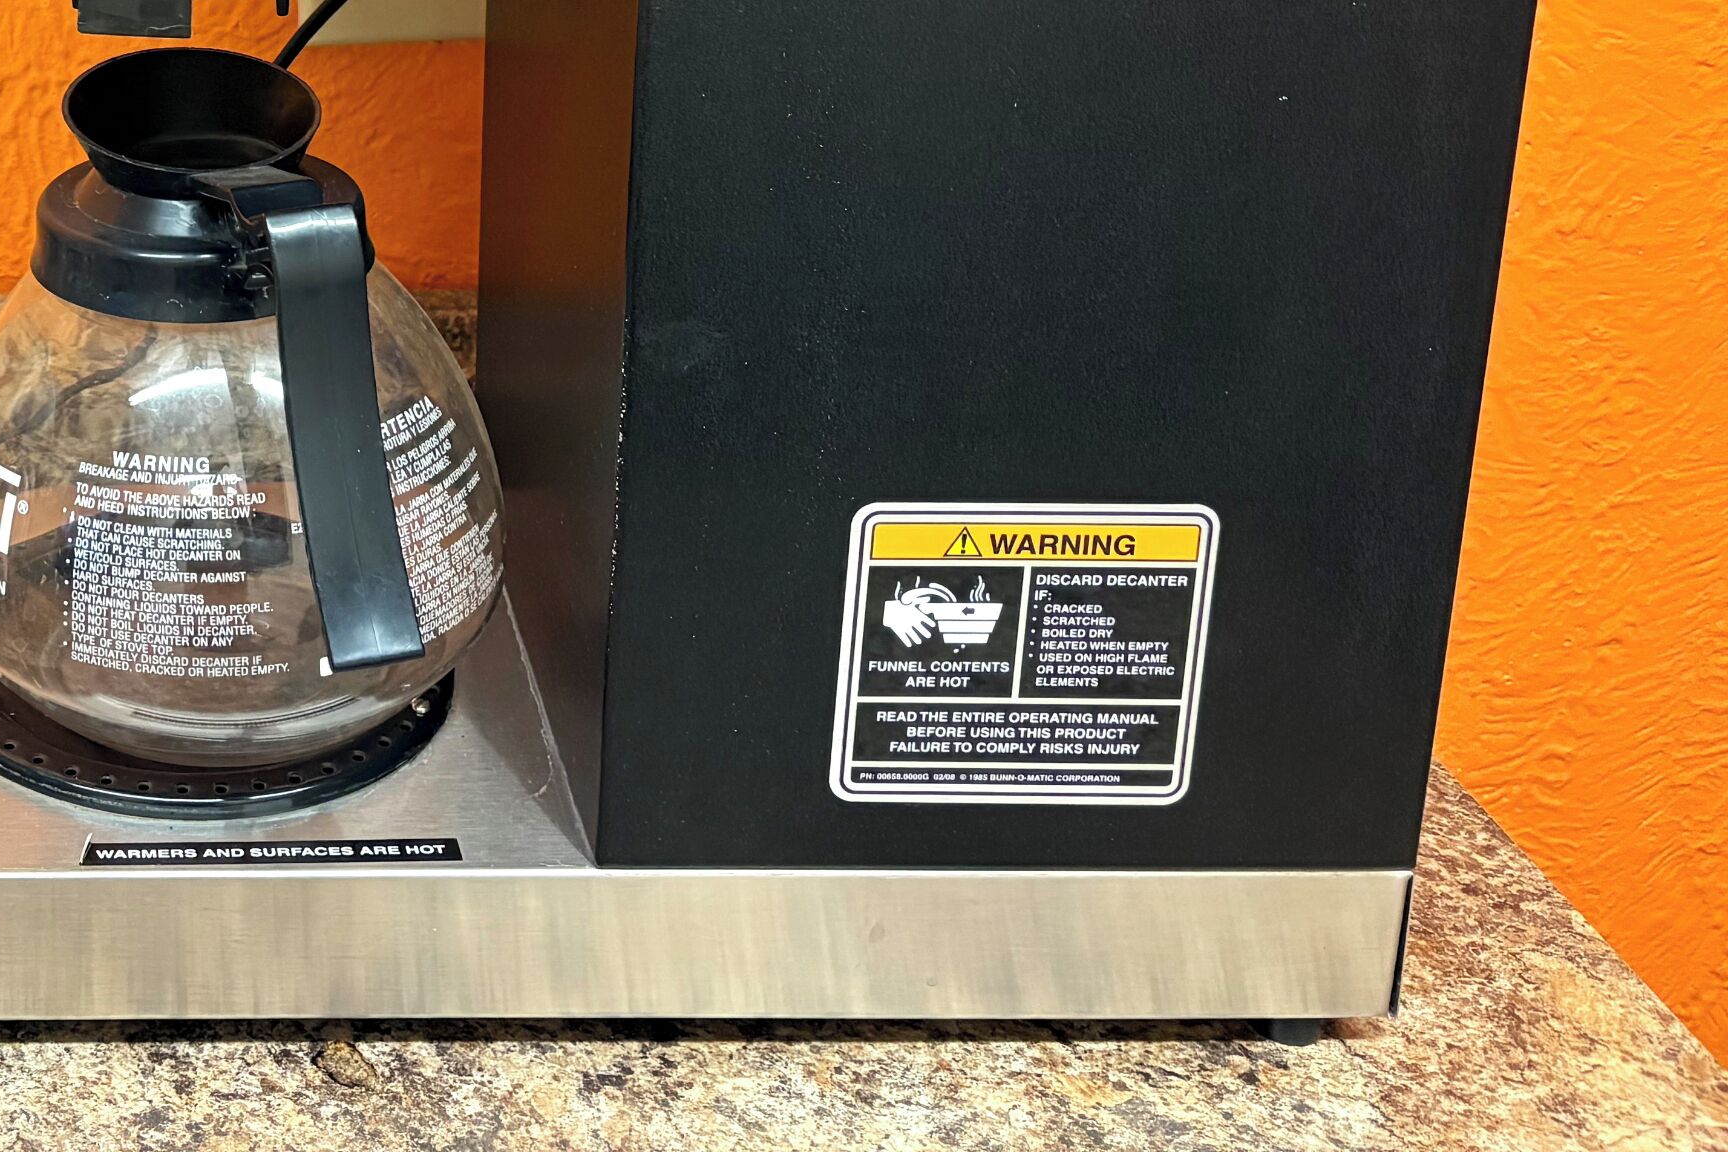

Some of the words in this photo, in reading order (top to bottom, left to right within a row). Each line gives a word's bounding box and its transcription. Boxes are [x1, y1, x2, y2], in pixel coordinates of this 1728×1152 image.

[380, 395, 434, 440] RTENCIA
[416, 406, 442, 434] LESIONES
[113, 451, 210, 473] WARNING
[391, 468, 407, 484] LEA
[413, 448, 441, 472] CUMPLA
[439, 438, 452, 455] LAS
[392, 454, 408, 470] LOS
[408, 434, 440, 462] PELIGROS
[78, 462, 128, 480] BREAKAGE
[130, 471, 152, 484] AND
[76, 482, 88, 494] TO
[90, 486, 120, 500] AVOID
[122, 490, 142, 504] THE
[144, 494, 180, 506] ABOVE
[183, 494, 234, 506] HAZARDS
[237, 492, 266, 506] READ
[74, 494, 95, 508] AND
[98, 499, 124, 514] HEED
[128, 504, 208, 520] INSTRUCTIONS
[77, 526, 100, 540] THAT
[101, 532, 120, 544] CAN
[123, 535, 154, 548] CAUSE
[158, 538, 224, 550] SCRATCHING.
[78, 516, 90, 528] DO
[92, 518, 112, 532] NOT
[114, 522, 144, 536] CLEAN
[146, 526, 172, 538] WITH
[176, 528, 232, 539] MATERIALS
[76, 537, 88, 548] DO
[91, 540, 110, 553] NOT
[112, 544, 143, 558] PLACE
[146, 548, 166, 560] HOT
[169, 550, 223, 561] DECANTER
[226, 550, 241, 560] ON
[990, 534, 1136, 556] WARNING
[74, 548, 122, 565] WET/COLD
[124, 558, 180, 572] SURFACES.
[74, 558, 87, 570] DO
[90, 562, 109, 574] NOT
[112, 566, 141, 578] BUMP
[144, 570, 198, 582] DECANTER
[200, 572, 246, 582] AGAINST
[73, 569, 98, 584] HARD
[102, 575, 156, 591] SURFACES.
[1036, 574, 1102, 586] DISCARD
[1106, 575, 1188, 586] DECANTER
[72, 580, 86, 591] DO
[88, 583, 109, 596] NOT
[111, 587, 139, 600] POUR
[142, 592, 204, 604] DECANTERS
[72, 590, 130, 610] CONTAINING
[134, 601, 176, 614] LIQUIDS
[180, 605, 226, 615] TOWARD
[230, 602, 274, 614] PEOPLE.
[1034, 590, 1052, 601] IF:
[72, 600, 86, 612] DO
[88, 604, 108, 616] NOT
[111, 609, 136, 621] HEAT
[138, 612, 191, 626] DECANTER
[198, 616, 207, 626] IF
[210, 614, 248, 625] EMPTY.
[1044, 604, 1102, 614] CRACKED
[72, 611, 86, 622] DO
[88, 614, 108, 627] NOT
[111, 619, 134, 632] BOIL
[137, 622, 179, 636] LIQUIDS
[184, 626, 194, 636] IN
[198, 625, 257, 636] DECANTER.
[1042, 616, 1116, 626] SCRATCHED
[72, 621, 86, 632] DO
[88, 624, 108, 638] NOT
[111, 630, 130, 641] USE
[134, 633, 189, 646] DECANTER
[192, 636, 208, 646] ON
[210, 636, 234, 646] ANY
[72, 631, 95, 645] TYPE
[100, 638, 112, 648] OF
[115, 640, 148, 654] STOVE
[151, 644, 174, 656] TOP.
[1042, 628, 1086, 638] BOILED
[1088, 629, 1114, 638] DRY
[72, 641, 138, 662] IMMEDIATELY
[141, 654, 188, 666] DISCARD
[192, 656, 249, 667] DECANTER
[252, 656, 262, 665] IF
[1040, 641, 1088, 650] HEATED
[1090, 642, 1125, 650] WHEN
[1128, 642, 1169, 650] EMPTY
[868, 660, 926, 672] FUNNEL
[930, 661, 1010, 672] CONTENTS
[1040, 653, 1072, 662] USED
[1074, 654, 1092, 662] ON
[1095, 654, 1124, 663] HIGH
[1128, 654, 1168, 663] FLAME
[136, 664, 184, 676] CRACKED
[188, 666, 204, 677] OR
[207, 666, 248, 678] HEATED
[251, 663, 290, 676] EMPTY.
[1036, 665, 1054, 674] OR
[1057, 665, 1114, 674] EXPOSED
[1116, 666, 1175, 675] ELECTRIC
[905, 676, 936, 688] ARE
[940, 676, 970, 688] HOT
[1035, 678, 1098, 686] ELEMENTS
[876, 711, 917, 722] READ
[920, 712, 948, 722] THE
[952, 712, 1005, 723] ENTIRE
[1008, 712, 1093, 724] OPERATING
[1097, 714, 1160, 724] MANUAL
[906, 726, 966, 738] BEFORE
[970, 727, 1016, 738] USING
[1018, 728, 1050, 738] THIS
[1054, 728, 1126, 740] PRODUCT
[890, 741, 950, 752] FAILURE
[953, 742, 972, 752] TO
[976, 742, 1036, 754] COMPLY
[1040, 743, 1084, 754] RISKS
[1088, 744, 1140, 754] INJURY
[1056, 774, 1120, 782] CORPORATION
[96, 848, 198, 859] WARMERS
[203, 848, 244, 858] AND
[250, 846, 354, 858] SURFACES
[360, 845, 400, 856] ARE
[406, 844, 446, 855] HOT
